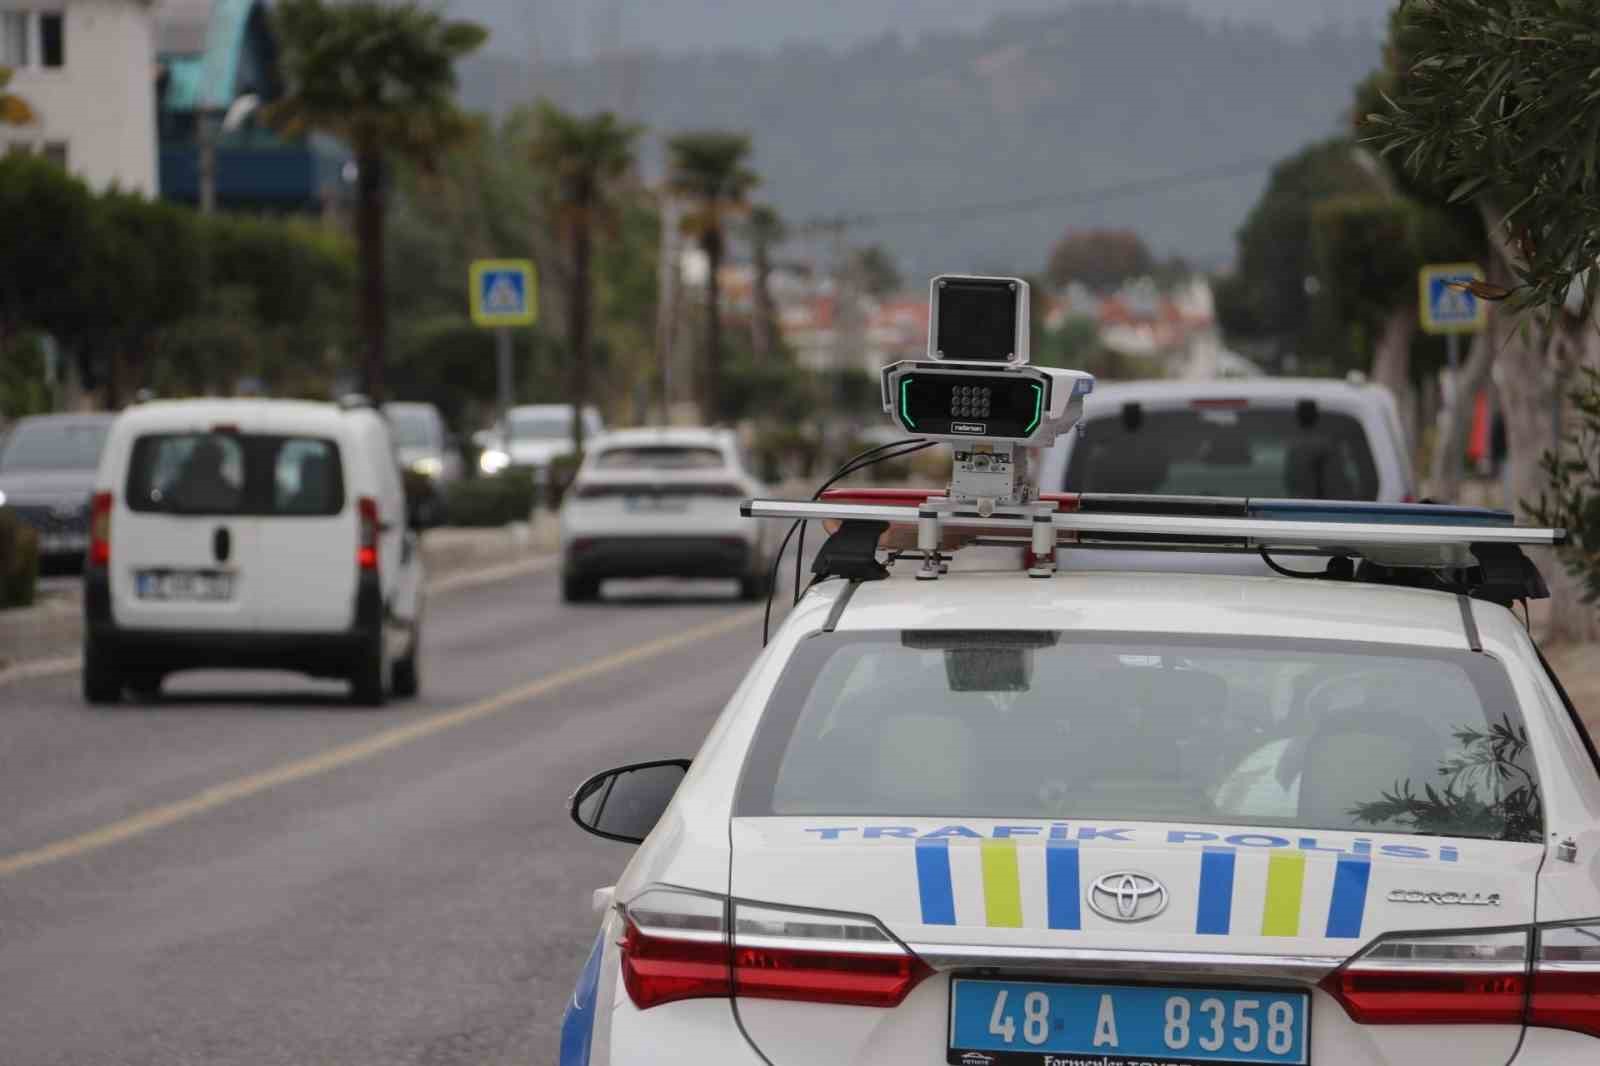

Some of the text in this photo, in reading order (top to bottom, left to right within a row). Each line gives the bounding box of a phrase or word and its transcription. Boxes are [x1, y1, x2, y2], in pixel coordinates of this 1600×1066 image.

[1387, 889, 1500, 906] COROLLA
[989, 990, 1294, 1055] 48 A 8358
